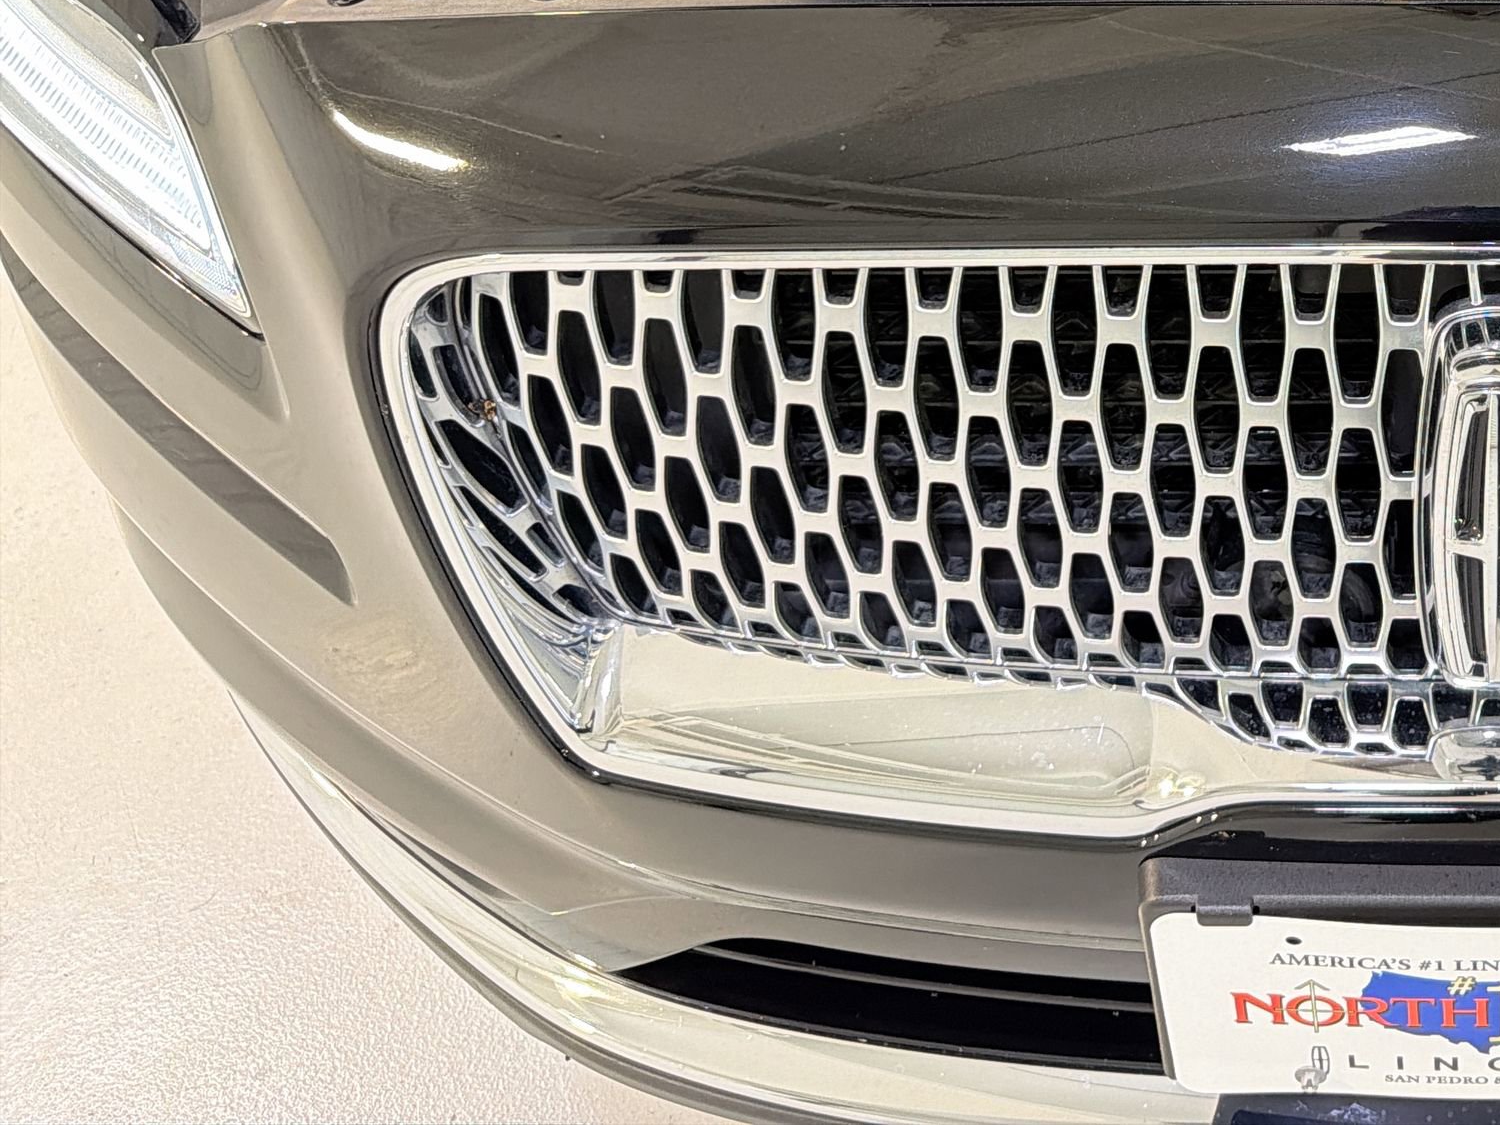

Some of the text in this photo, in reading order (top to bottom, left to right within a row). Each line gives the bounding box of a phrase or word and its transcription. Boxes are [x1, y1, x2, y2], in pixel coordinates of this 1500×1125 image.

[1268, 952, 1412, 971] AMERICA'S
[1418, 959, 1447, 971] #1
[1230, 991, 1490, 1028] NORTH
[1384, 1074, 1419, 1084] SAN
[1426, 1074, 1489, 1085] PEDRO
